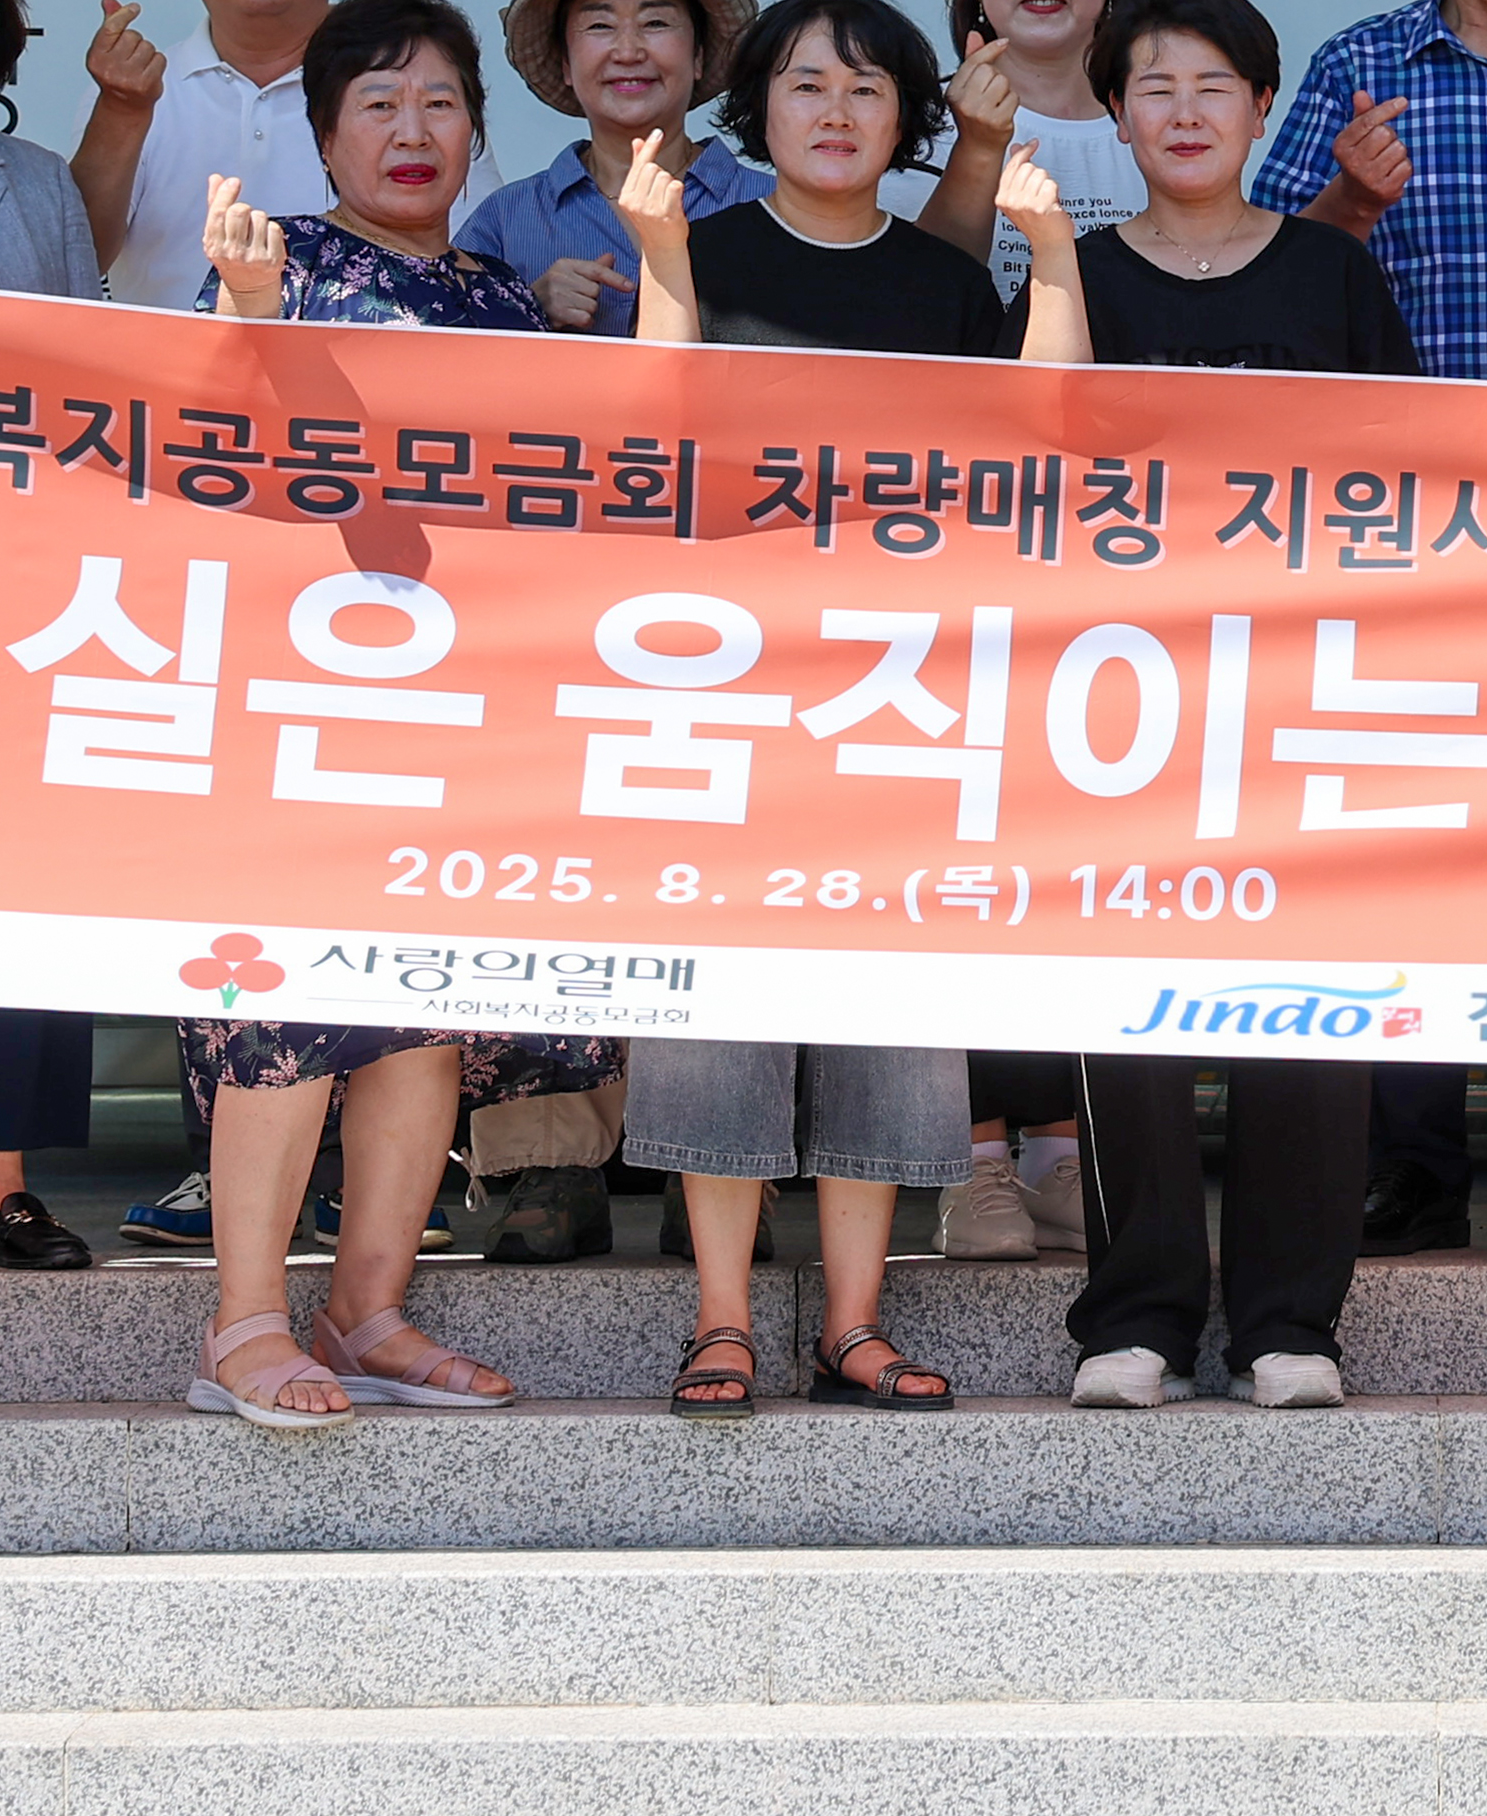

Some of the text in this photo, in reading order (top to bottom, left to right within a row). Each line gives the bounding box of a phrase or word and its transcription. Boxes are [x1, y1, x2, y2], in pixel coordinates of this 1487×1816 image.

[1089, 197, 1112, 210] you
[1003, 262, 1022, 273] Bit
[746, 441, 1168, 570] 차량매칭
[6, 558, 485, 810] 실은
[382, 844, 1278, 927] 2025. 8. 28.(목) 14:00
[309, 944, 698, 999] 사랑의열매
[420, 998, 692, 1027] 사회복지공동모금회
[1119, 987, 1373, 1038] Jindo
